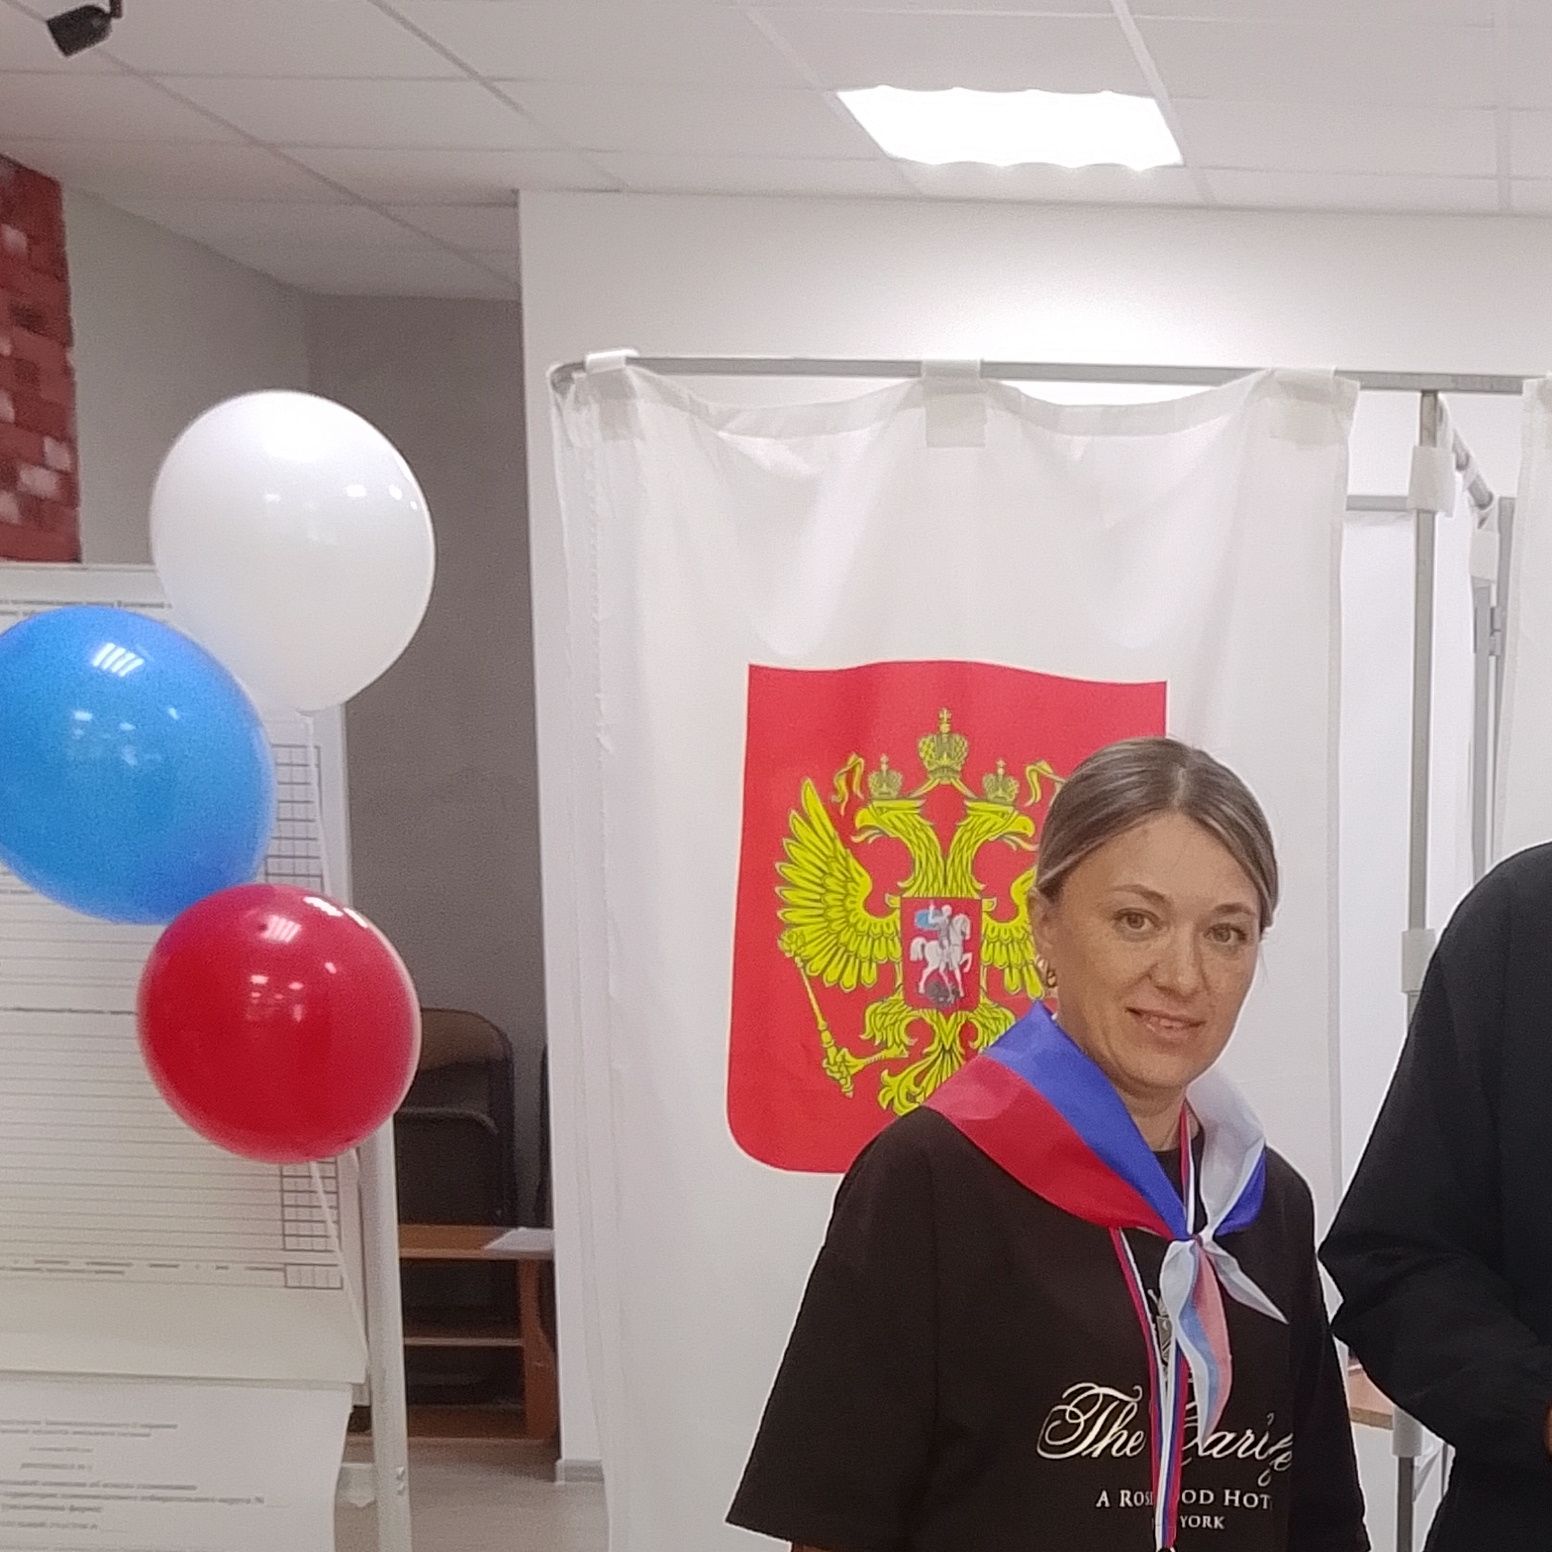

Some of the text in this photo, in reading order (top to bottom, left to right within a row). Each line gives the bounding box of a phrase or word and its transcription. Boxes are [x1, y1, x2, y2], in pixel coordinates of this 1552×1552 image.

[1037, 1382, 1146, 1460] The
[1096, 1489, 1111, 1508] A
[1119, 1489, 1215, 1508] ROSOD
[1180, 1515, 1226, 1530] YORK
